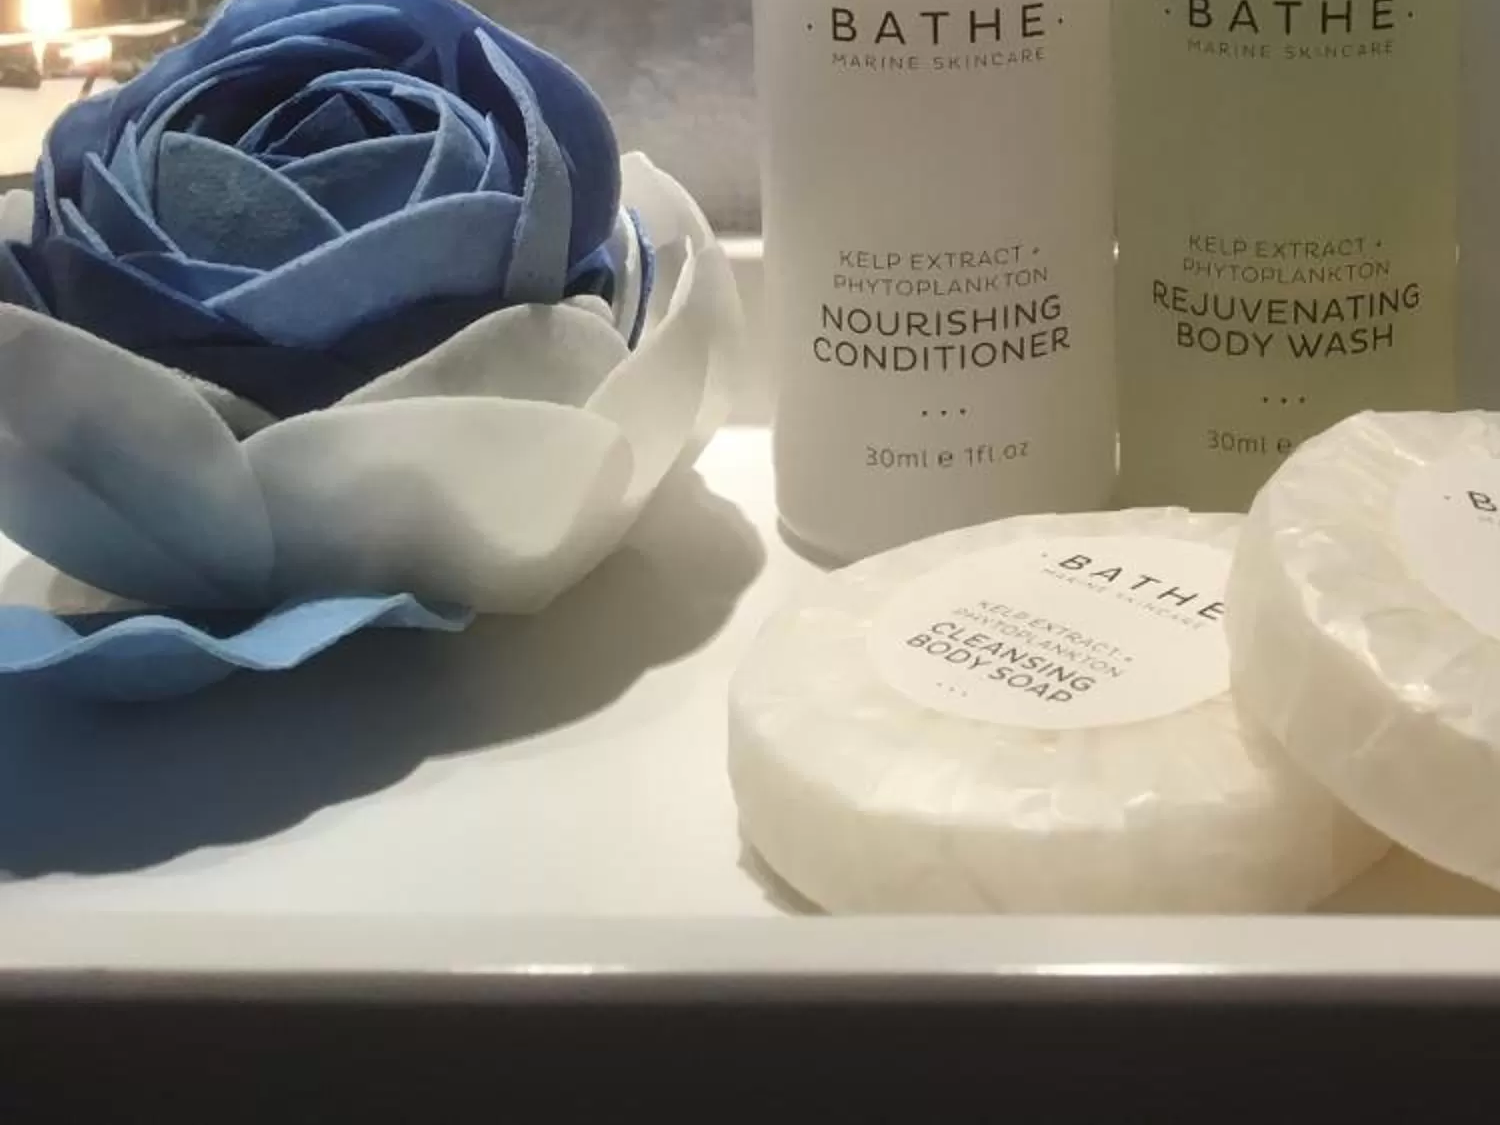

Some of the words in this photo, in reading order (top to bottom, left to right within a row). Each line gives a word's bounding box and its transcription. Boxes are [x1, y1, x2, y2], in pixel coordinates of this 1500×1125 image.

[831, 2, 1045, 45] BATHE
[831, 51, 921, 71] MARINE
[933, 46, 1047, 71] SKINCARE
[1187, 38, 1271, 59] MARINE
[1284, 39, 1394, 60] SKINCARE
[839, 250, 901, 270] KELP
[911, 244, 1024, 271] EXTRACT
[1188, 234, 1246, 256] KELP
[1256, 237, 1365, 259] EXTRACT
[833, 266, 1048, 297] PHYTOPLANKTON
[1183, 257, 1391, 284] PHYTOPLANKTON
[822, 294, 1061, 337] NOURISHING
[1153, 278, 1421, 324] REJUVENATING
[813, 326, 1071, 371] CONDITIONER
[1177, 322, 1274, 357] BODY
[1288, 323, 1394, 358] WASH
[865, 446, 928, 468] 30ml
[1207, 429, 1267, 454] 30ml
[1058, 554, 1225, 620] BATHE
[906, 632, 994, 671] BODY
[987, 666, 1074, 703] SOAP
[931, 622, 1096, 693] CLEANSING
